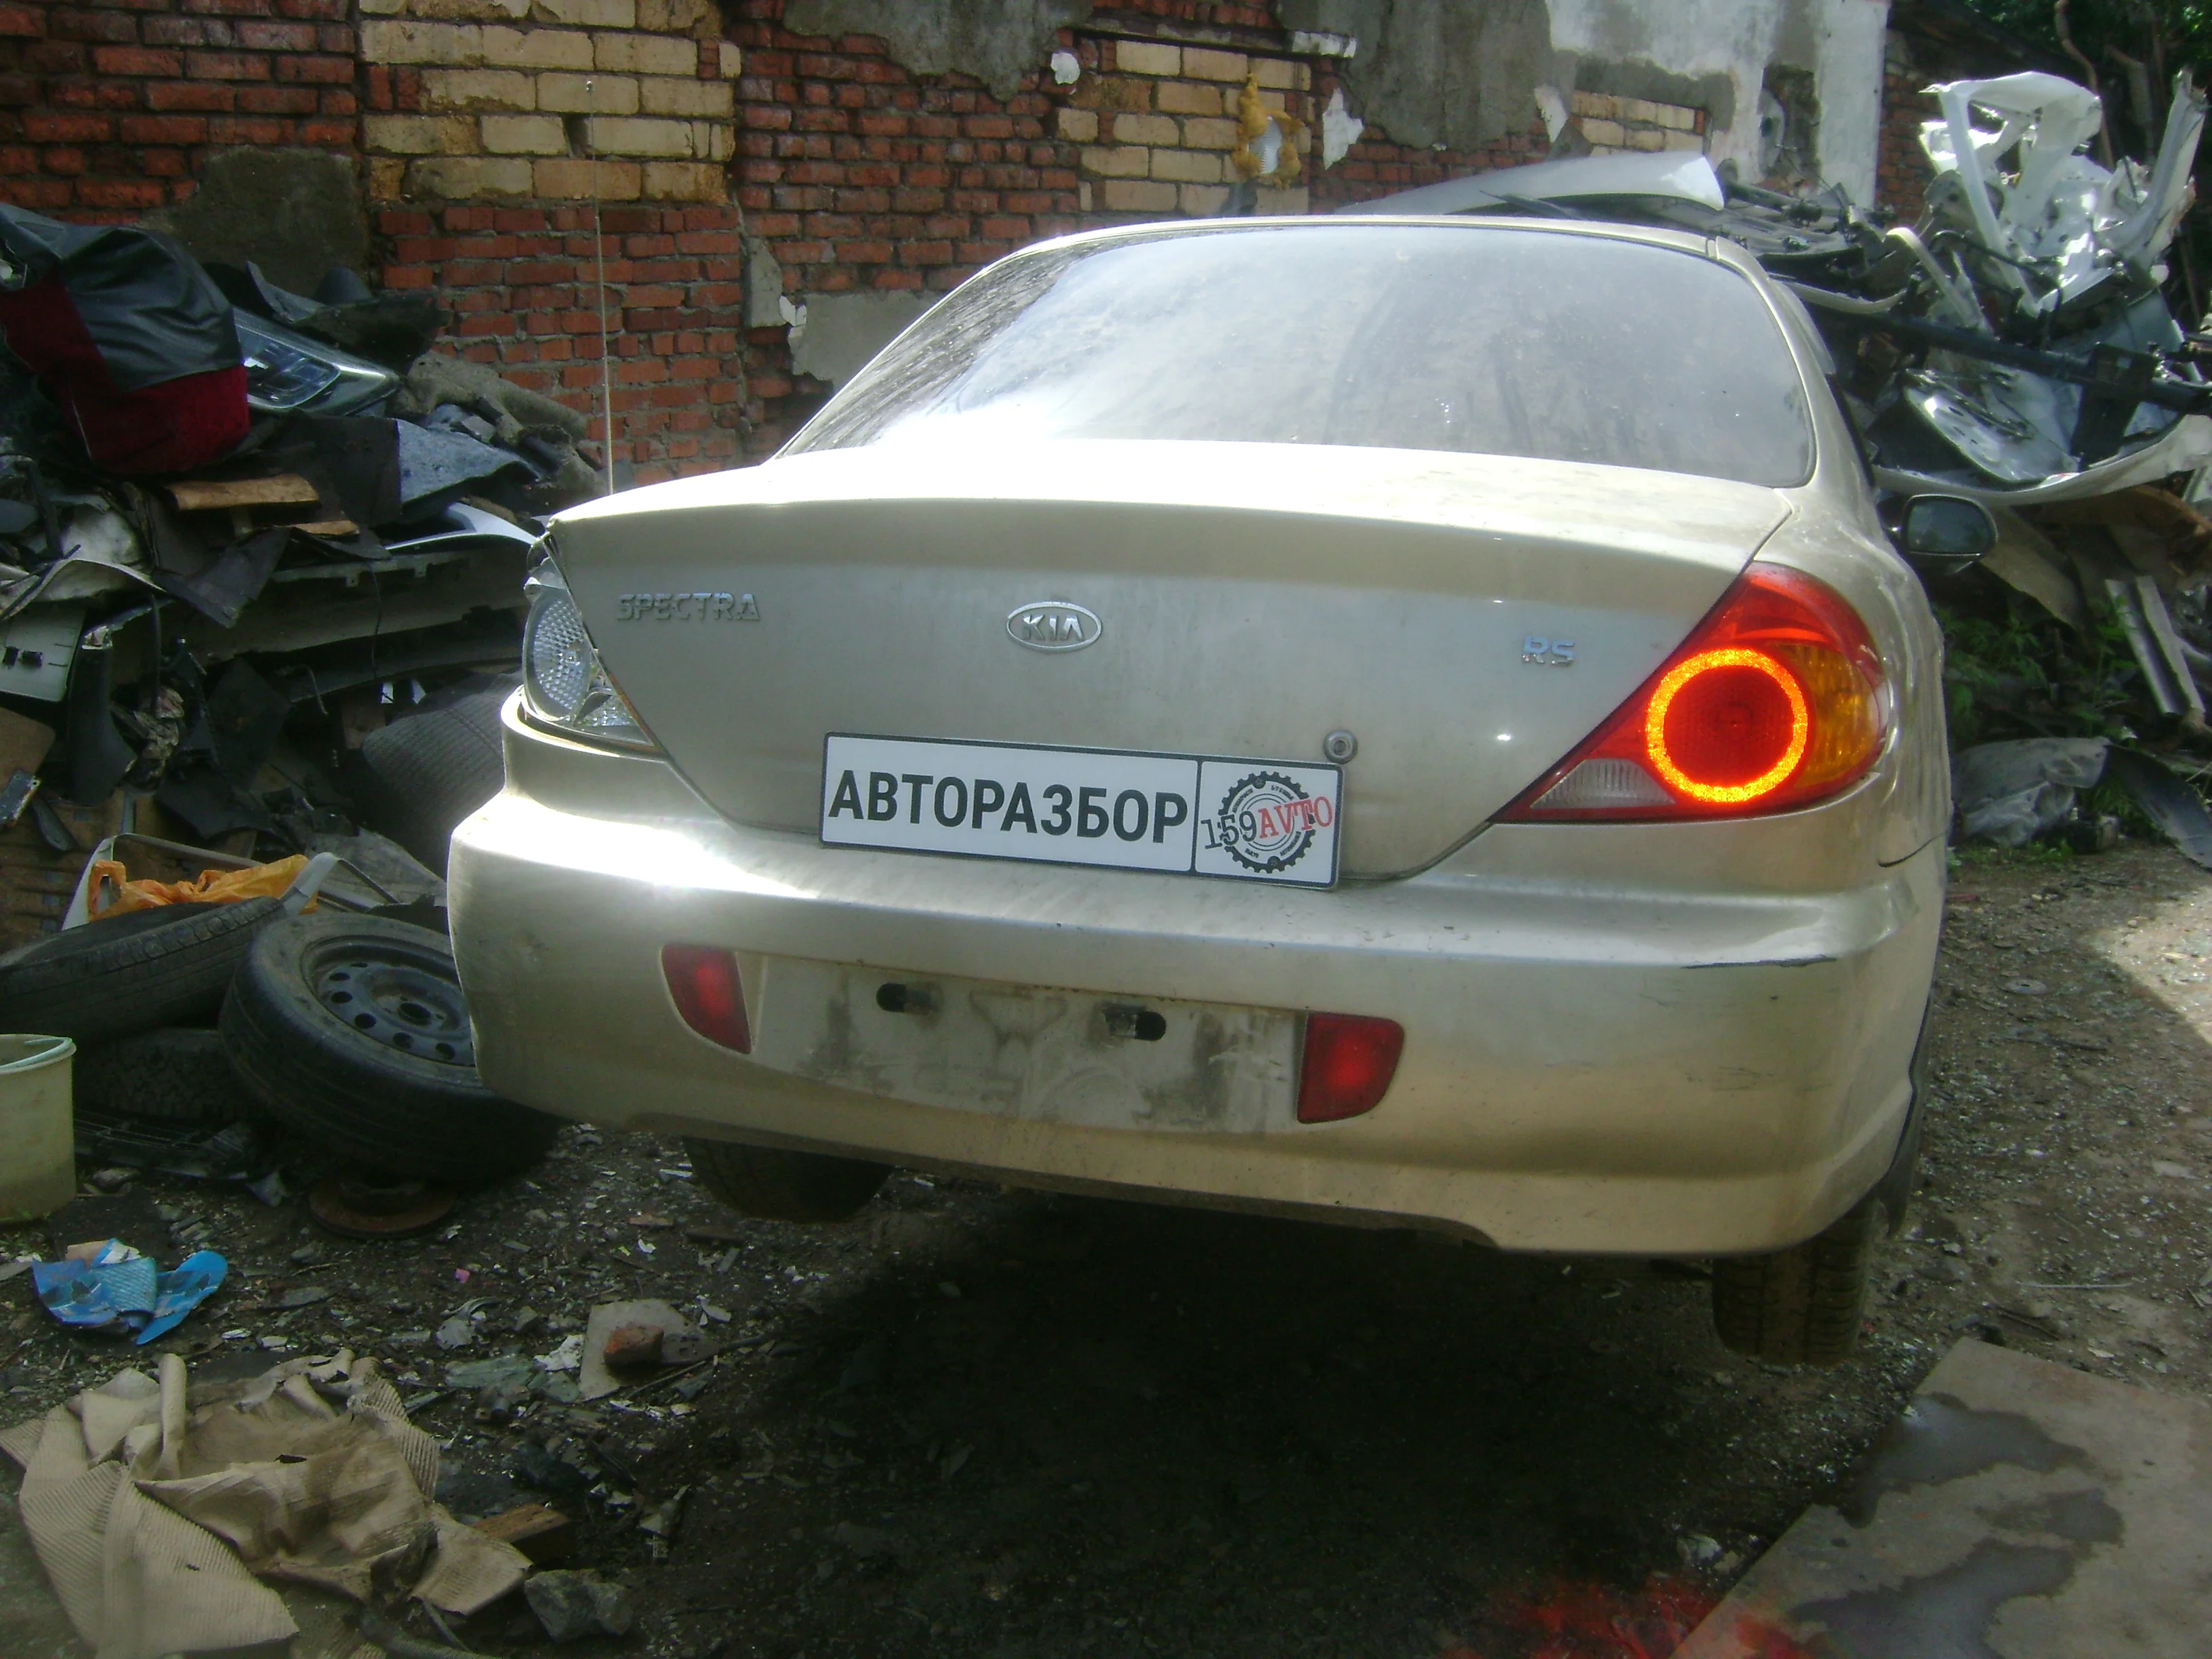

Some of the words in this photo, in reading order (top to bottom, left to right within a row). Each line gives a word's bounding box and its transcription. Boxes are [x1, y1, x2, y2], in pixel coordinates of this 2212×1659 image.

[617, 592, 760, 621] SPECTRA
[1022, 613, 1084, 641] KIA
[1522, 636, 1576, 666] RS
[827, 769, 1188, 844] АВТОРАЗБОР
